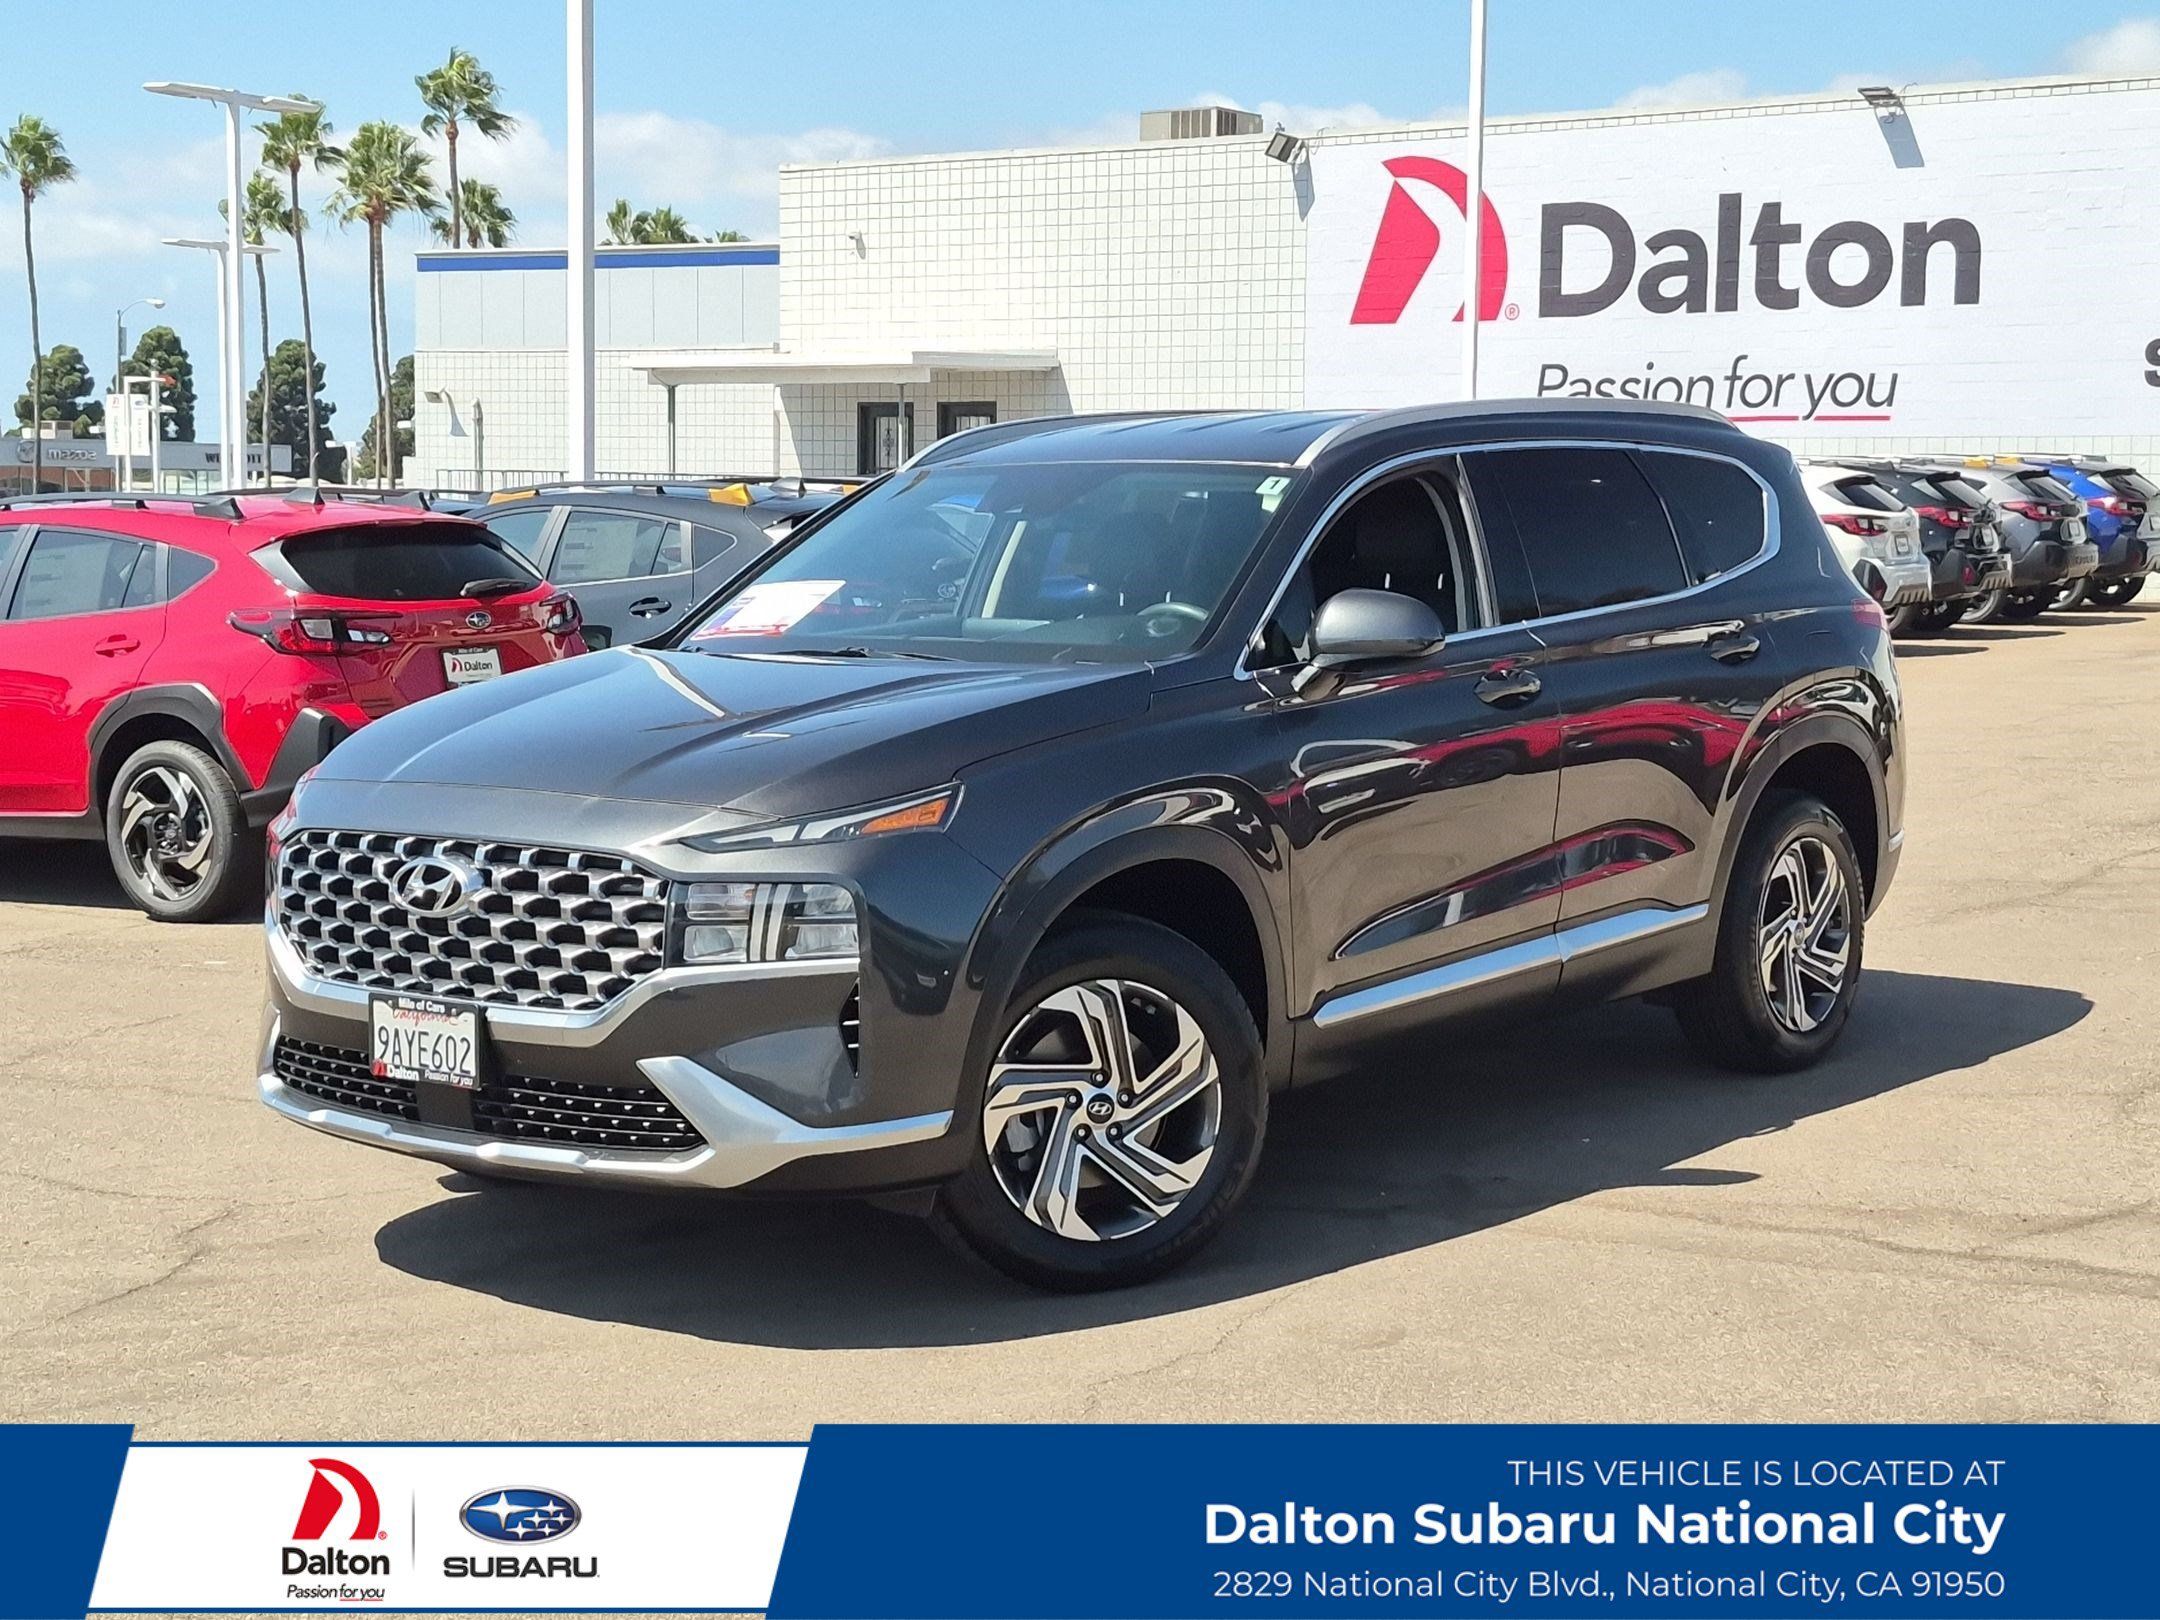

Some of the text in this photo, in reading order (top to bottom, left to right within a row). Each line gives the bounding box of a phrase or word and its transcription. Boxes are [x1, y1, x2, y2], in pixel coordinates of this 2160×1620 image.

[1539, 192, 1982, 318] Dalton
[1723, 354, 1796, 409] for
[1803, 371, 1899, 421] you
[464, 660, 493, 672] Dalton
[416, 1000, 425, 1010] of
[426, 1001, 445, 1013] Cars
[378, 1025, 471, 1075] 9AYE602
[387, 1064, 474, 1087] Dalton Passion for you
